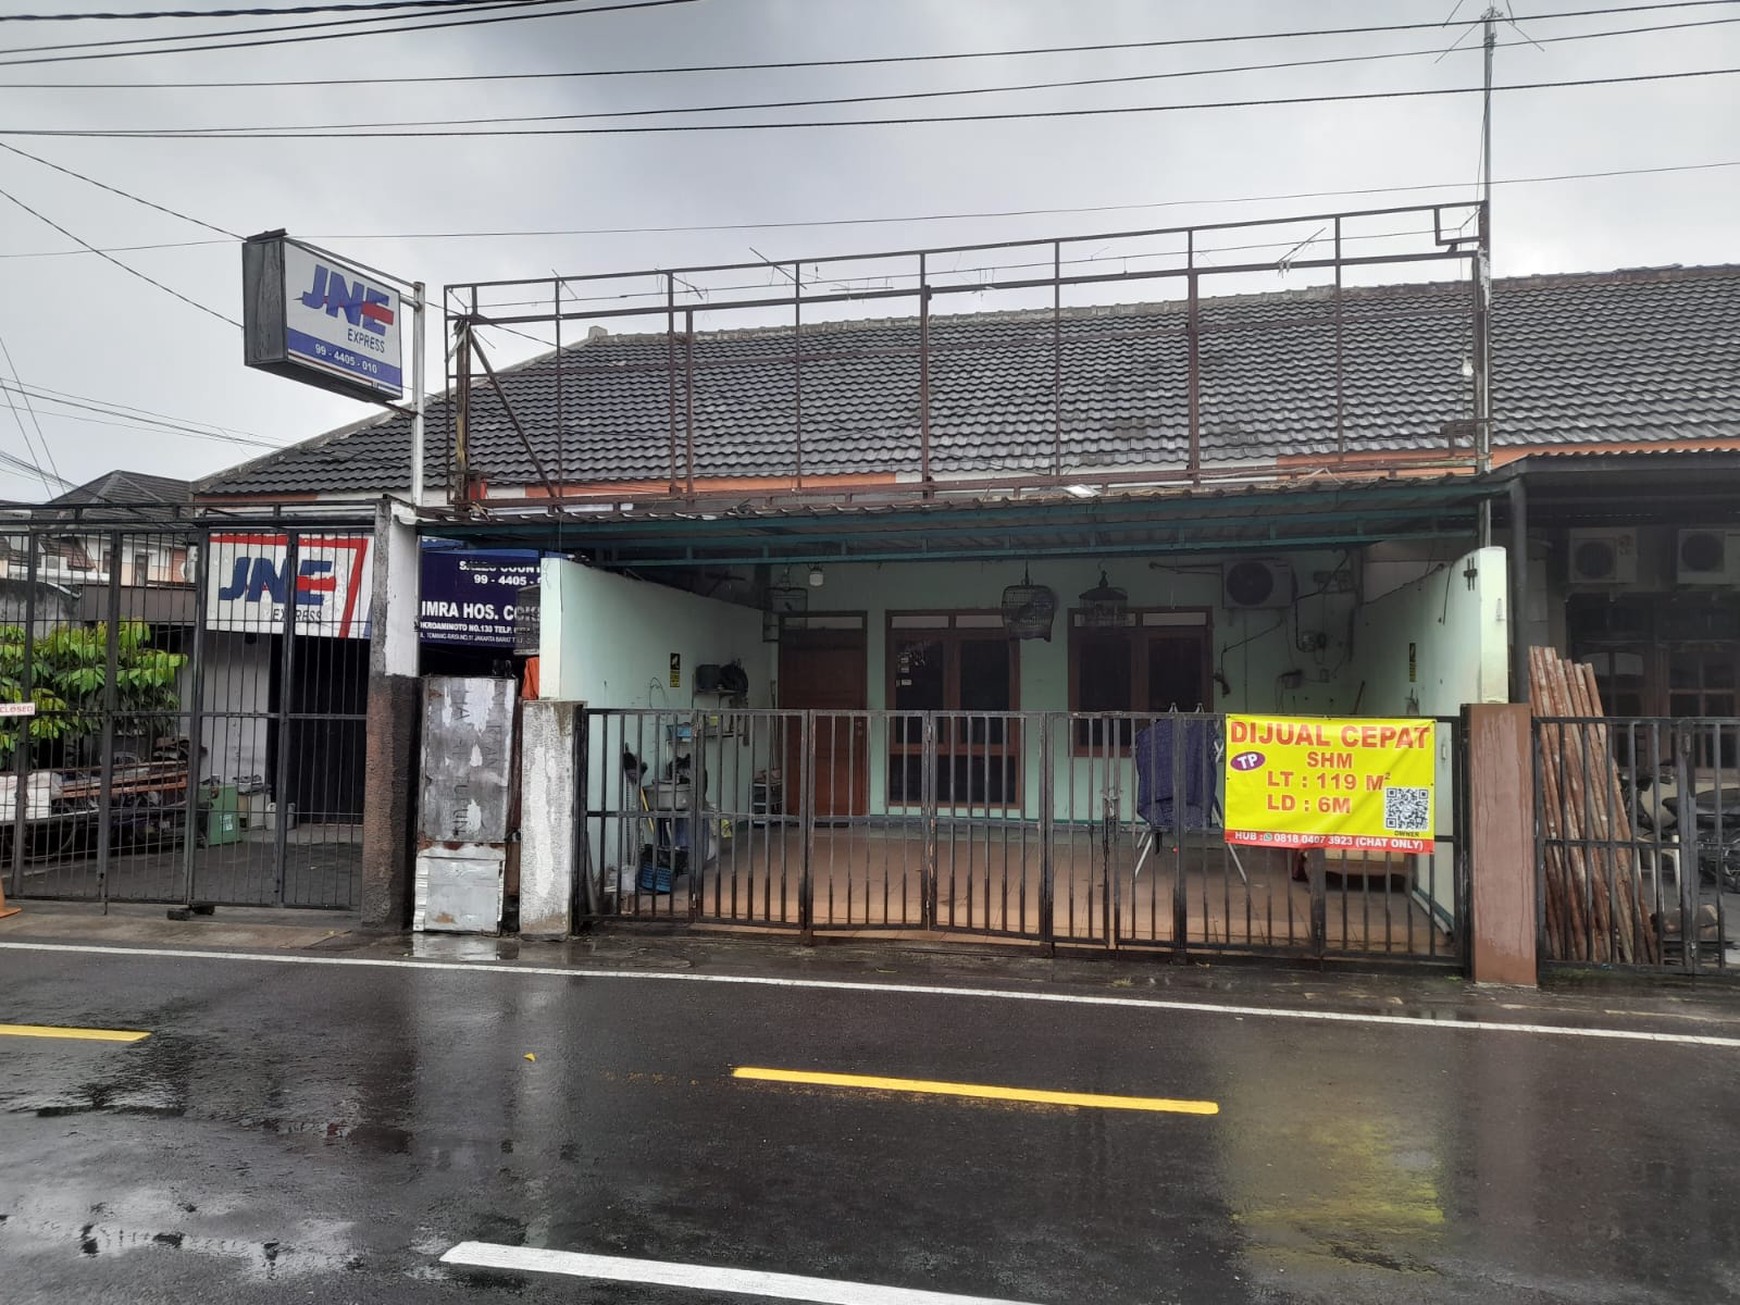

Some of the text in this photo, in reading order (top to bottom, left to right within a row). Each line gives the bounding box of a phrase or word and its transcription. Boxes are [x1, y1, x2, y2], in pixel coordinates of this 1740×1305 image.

[300, 264, 394, 337] JNE
[347, 327, 385, 354] EXPRESS
[314, 343, 327, 356] 99
[333, 350, 356, 366] 4405
[361, 362, 378, 374] 010
[219, 556, 336, 606] JNE
[473, 573, 488, 584] 99
[497, 575, 527, 586] 4405
[273, 608, 322, 622] EXRESS
[462, 602, 498, 620] HOS.
[1230, 721, 1431, 749] DIJUAL CEPAT
[1237, 754, 1258, 770] TP
[1306, 751, 1353, 768] SHM
[1267, 770, 1294, 787] LT
[1316, 773, 1357, 790] 119
[1267, 794, 1296, 811] LD
[1318, 797, 1351, 814] 6M
[1235, 831, 1256, 841] HUB
[1274, 833, 1299, 843] 0818
[1301, 835, 1325, 844] 0407
[1328, 836, 1353, 846] 3923
[1355, 836, 1388, 848] (CHAT
[1391, 838, 1425, 851] ONLY)
